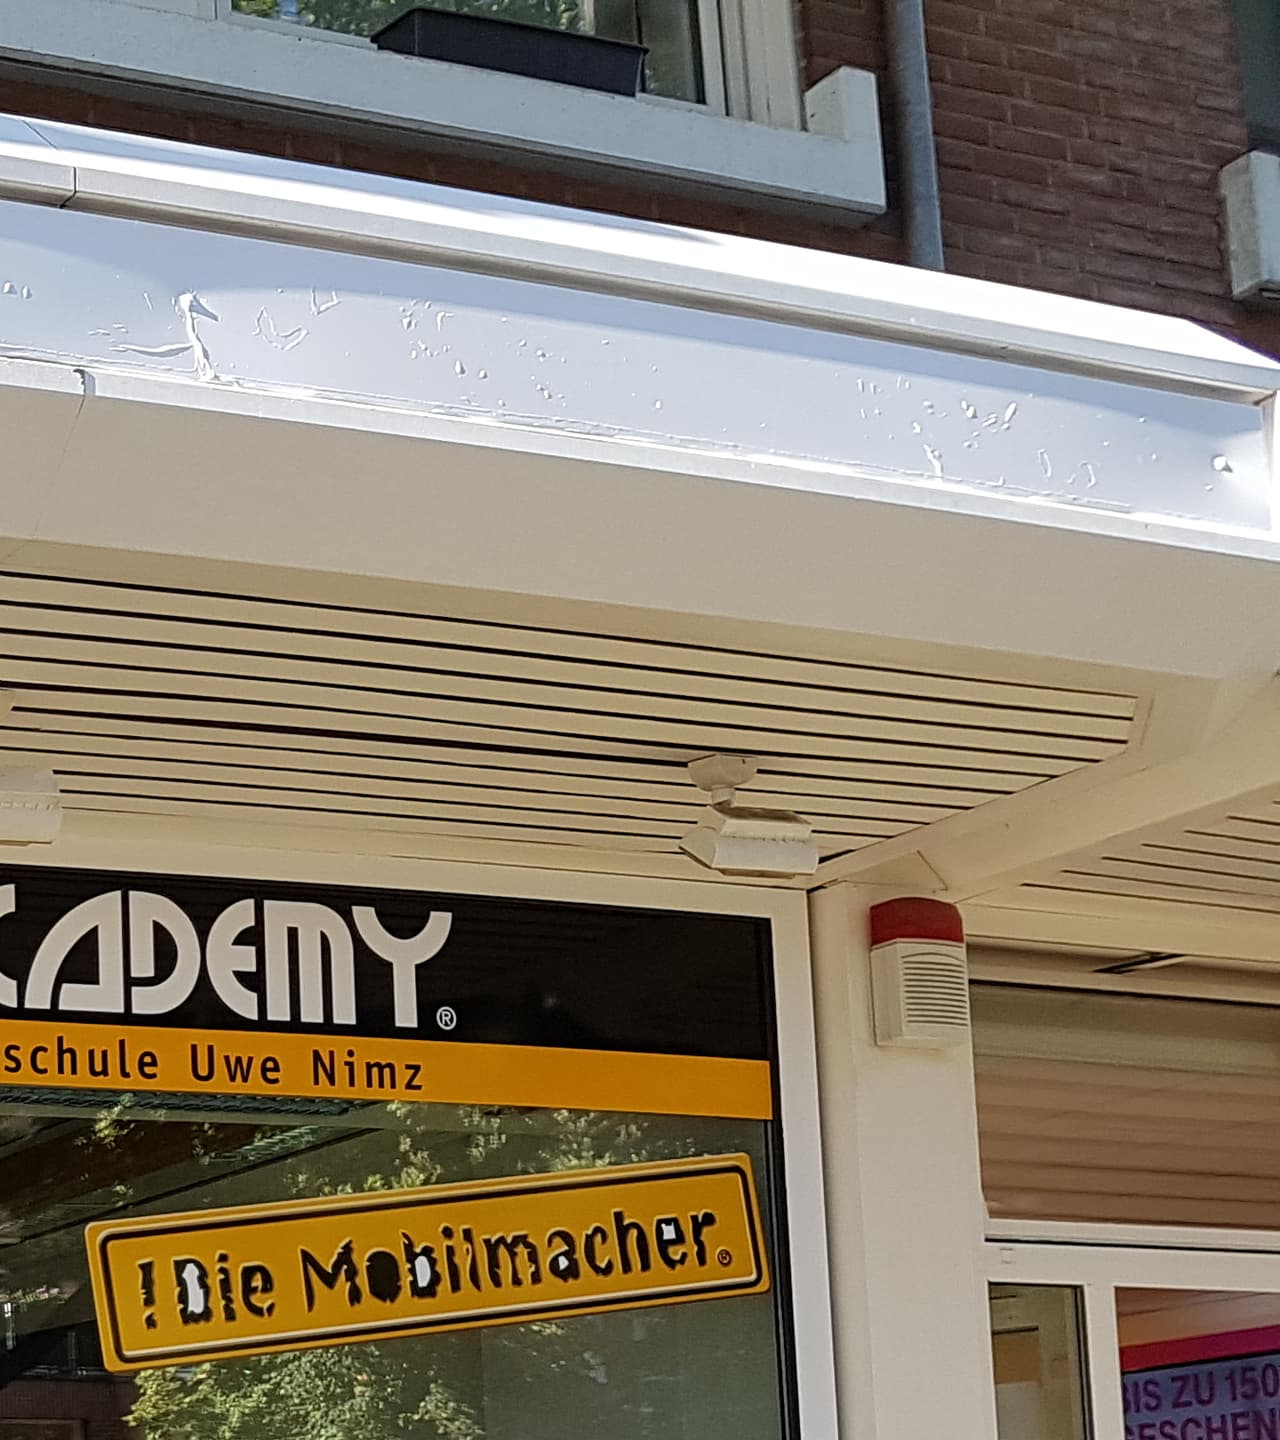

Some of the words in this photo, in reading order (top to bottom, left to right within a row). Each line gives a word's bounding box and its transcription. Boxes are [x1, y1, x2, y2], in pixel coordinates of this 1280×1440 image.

[189, 1043, 281, 1085] Uwe
[312, 1049, 424, 1091] Nimz
[173, 1251, 276, 1326] Die
[1171, 1370, 1216, 1409] ZU
